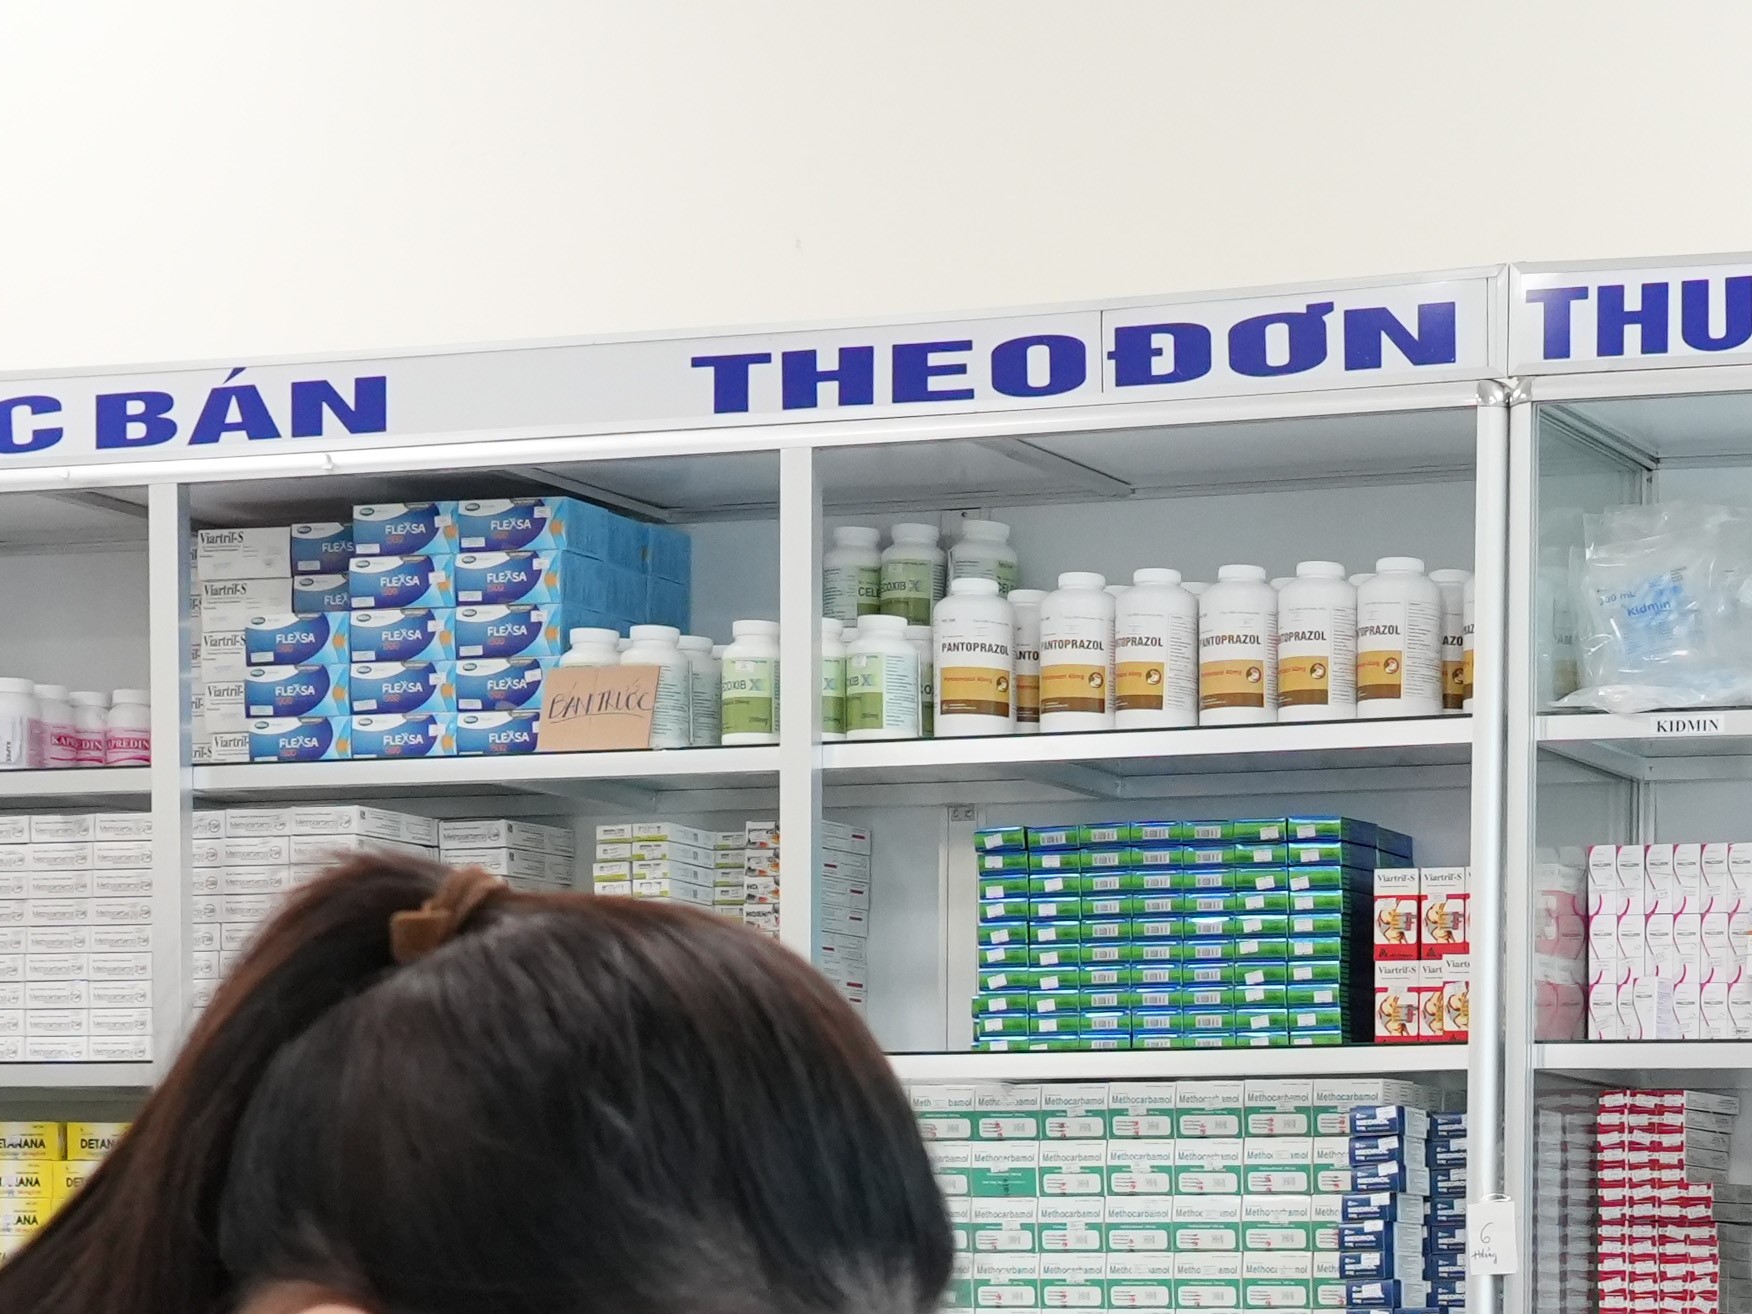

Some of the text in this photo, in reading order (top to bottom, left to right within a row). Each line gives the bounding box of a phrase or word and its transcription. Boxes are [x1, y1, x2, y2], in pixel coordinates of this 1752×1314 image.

[95, 367, 387, 450] BÁN
[385, 521, 427, 535] FLEXSA
[490, 517, 532, 532] FLEXSA
[380, 574, 420, 588] FLEXSA
[486, 570, 527, 585] FLEXSA
[275, 631, 316, 645] FLEXSA
[487, 624, 527, 639] FLEXSA
[941, 642, 1010, 656] PANTOPRAZOL
[1656, 719, 1720, 733] KIDMIN
